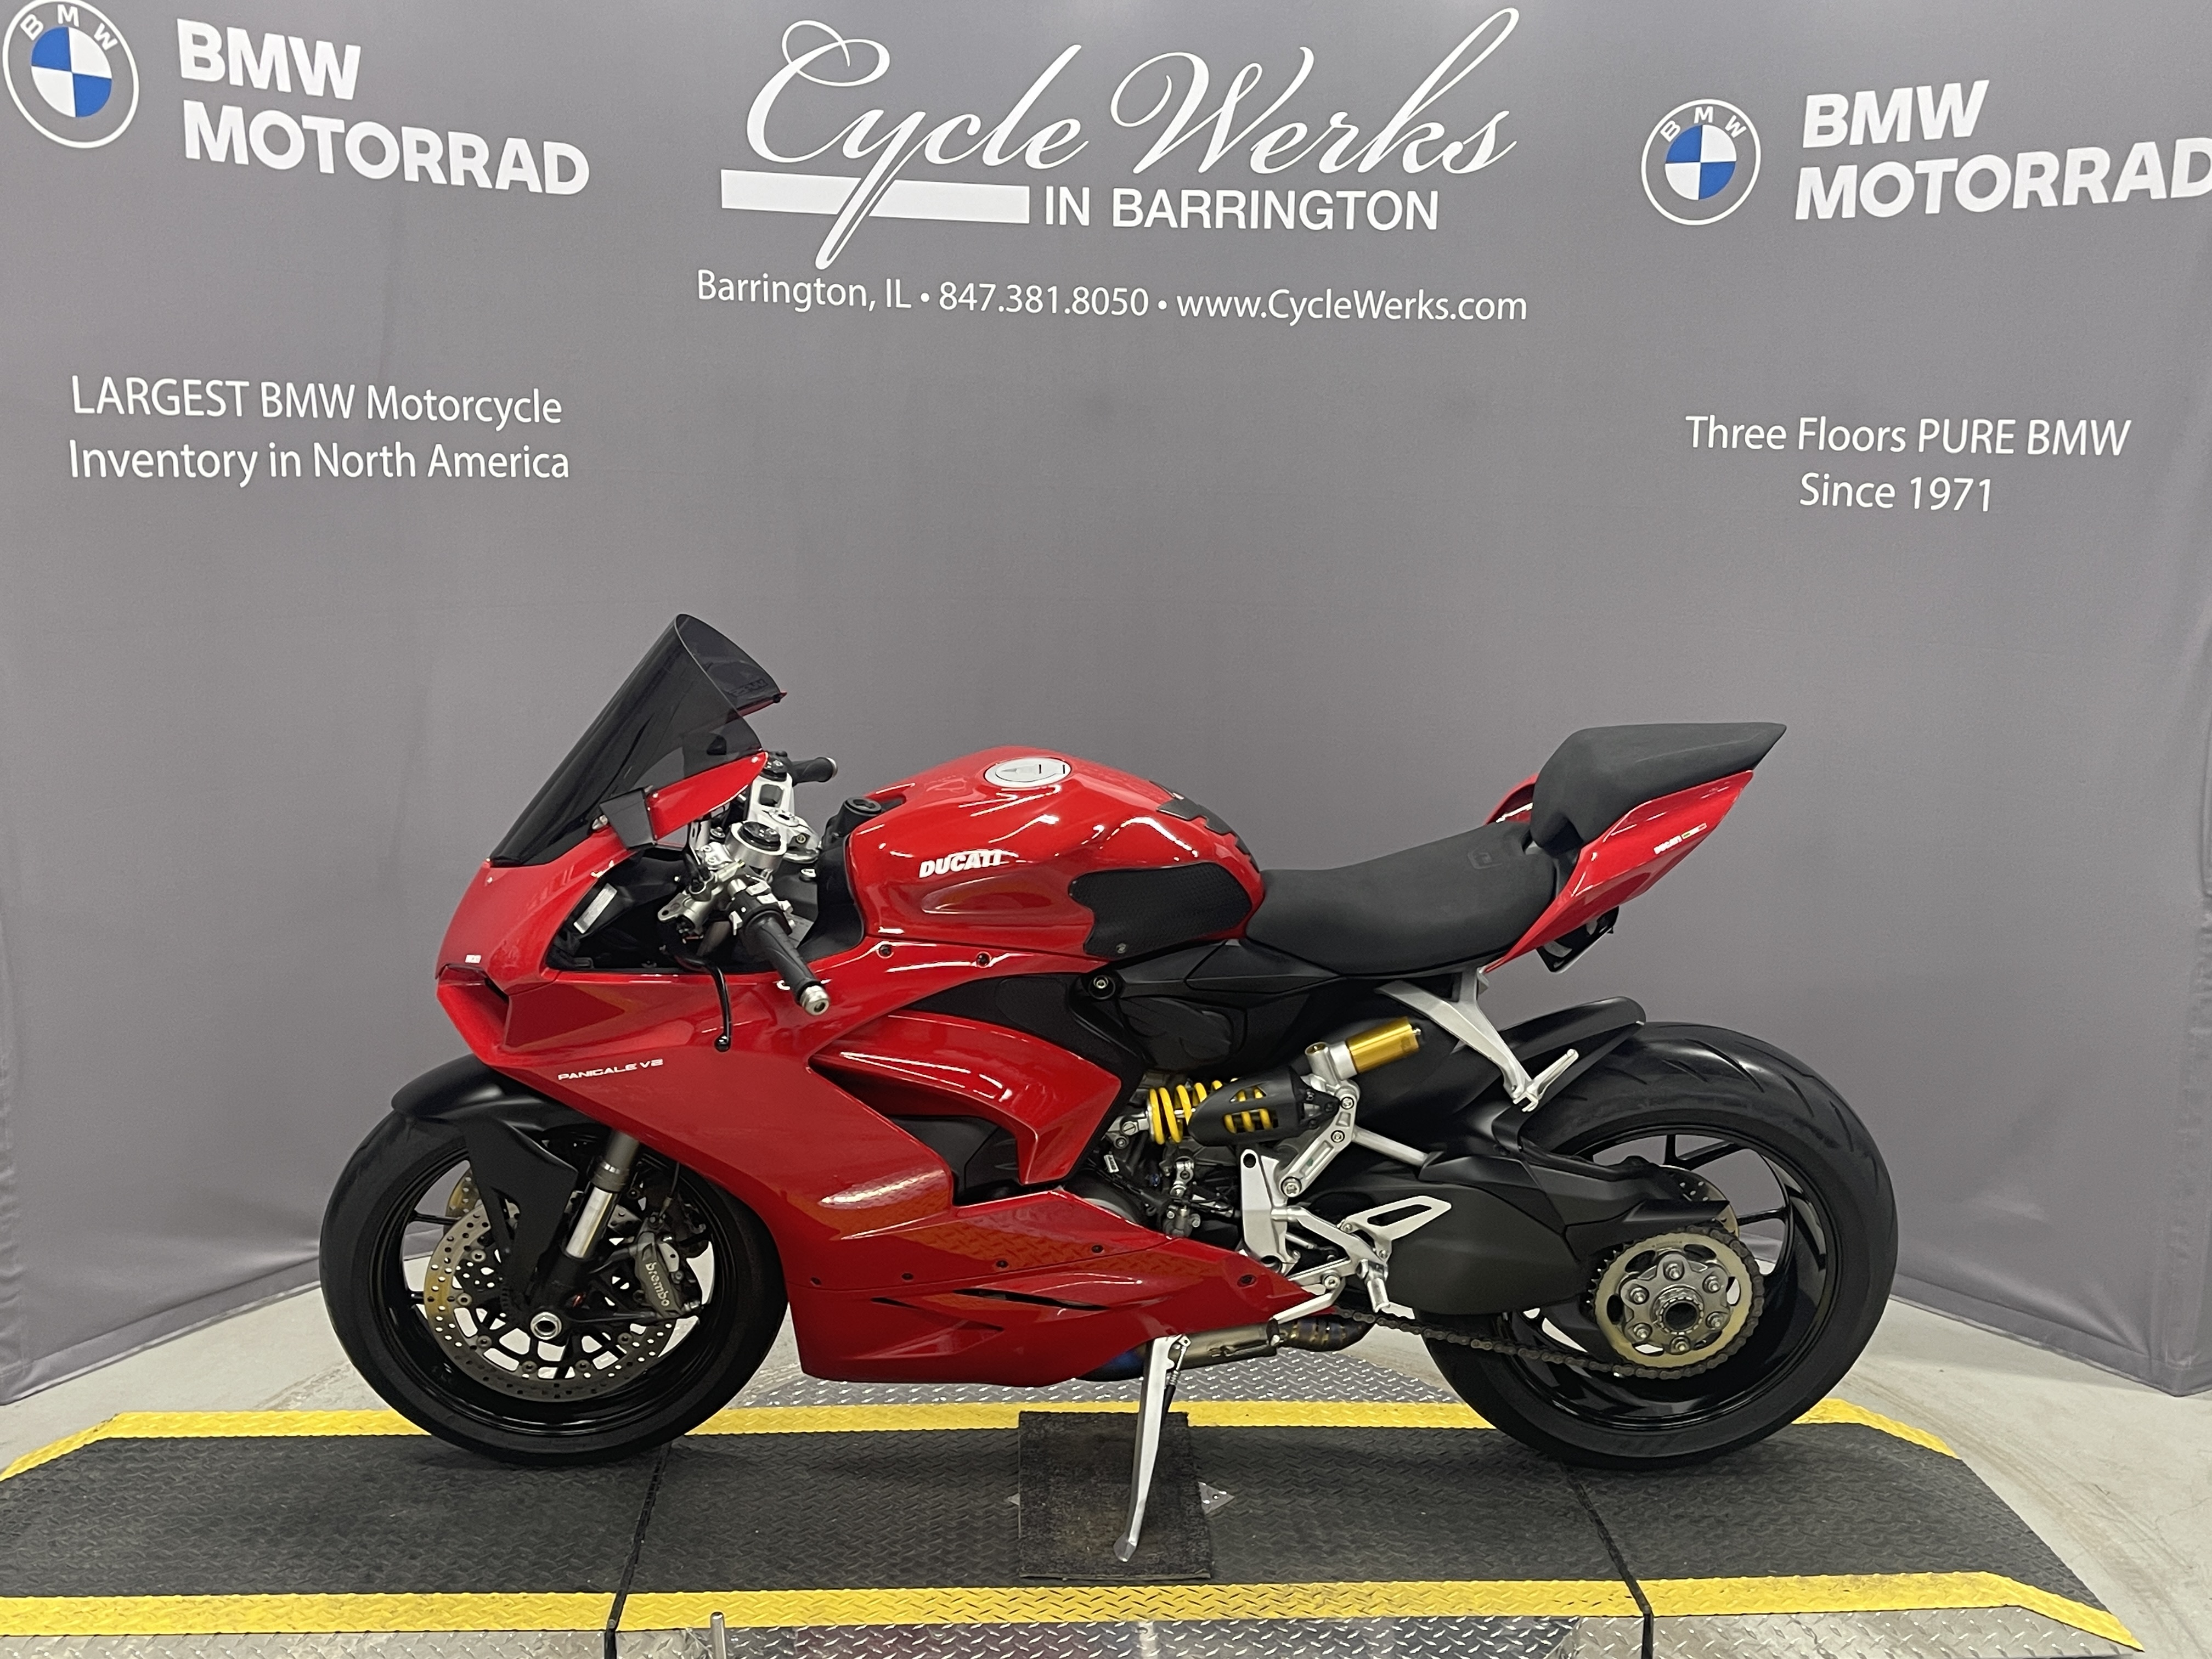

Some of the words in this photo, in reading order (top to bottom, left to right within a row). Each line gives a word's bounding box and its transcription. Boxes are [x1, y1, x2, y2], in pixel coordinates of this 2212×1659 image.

[20, 4, 117, 50] BMW
[177, 19, 361, 100] BMW
[1660, 106, 1747, 142] BMW
[1803, 80, 1990, 148] BMW
[184, 100, 590, 195] MOTORRAD
[747, 20, 1089, 270] Cycle
[1110, 8, 1520, 174] Werks
[1795, 137, 2212, 220] MOTORRAD
[1046, 185, 1090, 226] IN
[1113, 188, 1438, 231] BARRINGTON
[698, 269, 876, 312] Barrington,
[886, 278, 912, 308] IL
[939, 281, 1149, 316] 847.381.8050
[1176, 288, 1527, 326] www.CycleWerks.com
[72, 375, 250, 417] LARGEST
[261, 381, 356, 419] BMW
[368, 385, 562, 432] Motorcycle
[1685, 414, 1787, 450] Three
[1798, 415, 1906, 453] Floors
[1918, 418, 2016, 454] PURE
[2027, 419, 2132, 456] BMW
[70, 439, 258, 488] Inventory
[269, 442, 301, 477] in
[313, 441, 416, 477] North
[427, 443, 569, 478] America
[1799, 472, 1895, 509] Since
[1910, 477, 1991, 512] 1971
[919, 850, 1002, 878] DUCATI
[557, 1063, 637, 1080] PANIGALE
[639, 1058, 663, 1068] V2
[645, 1262, 669, 1306] brembo
